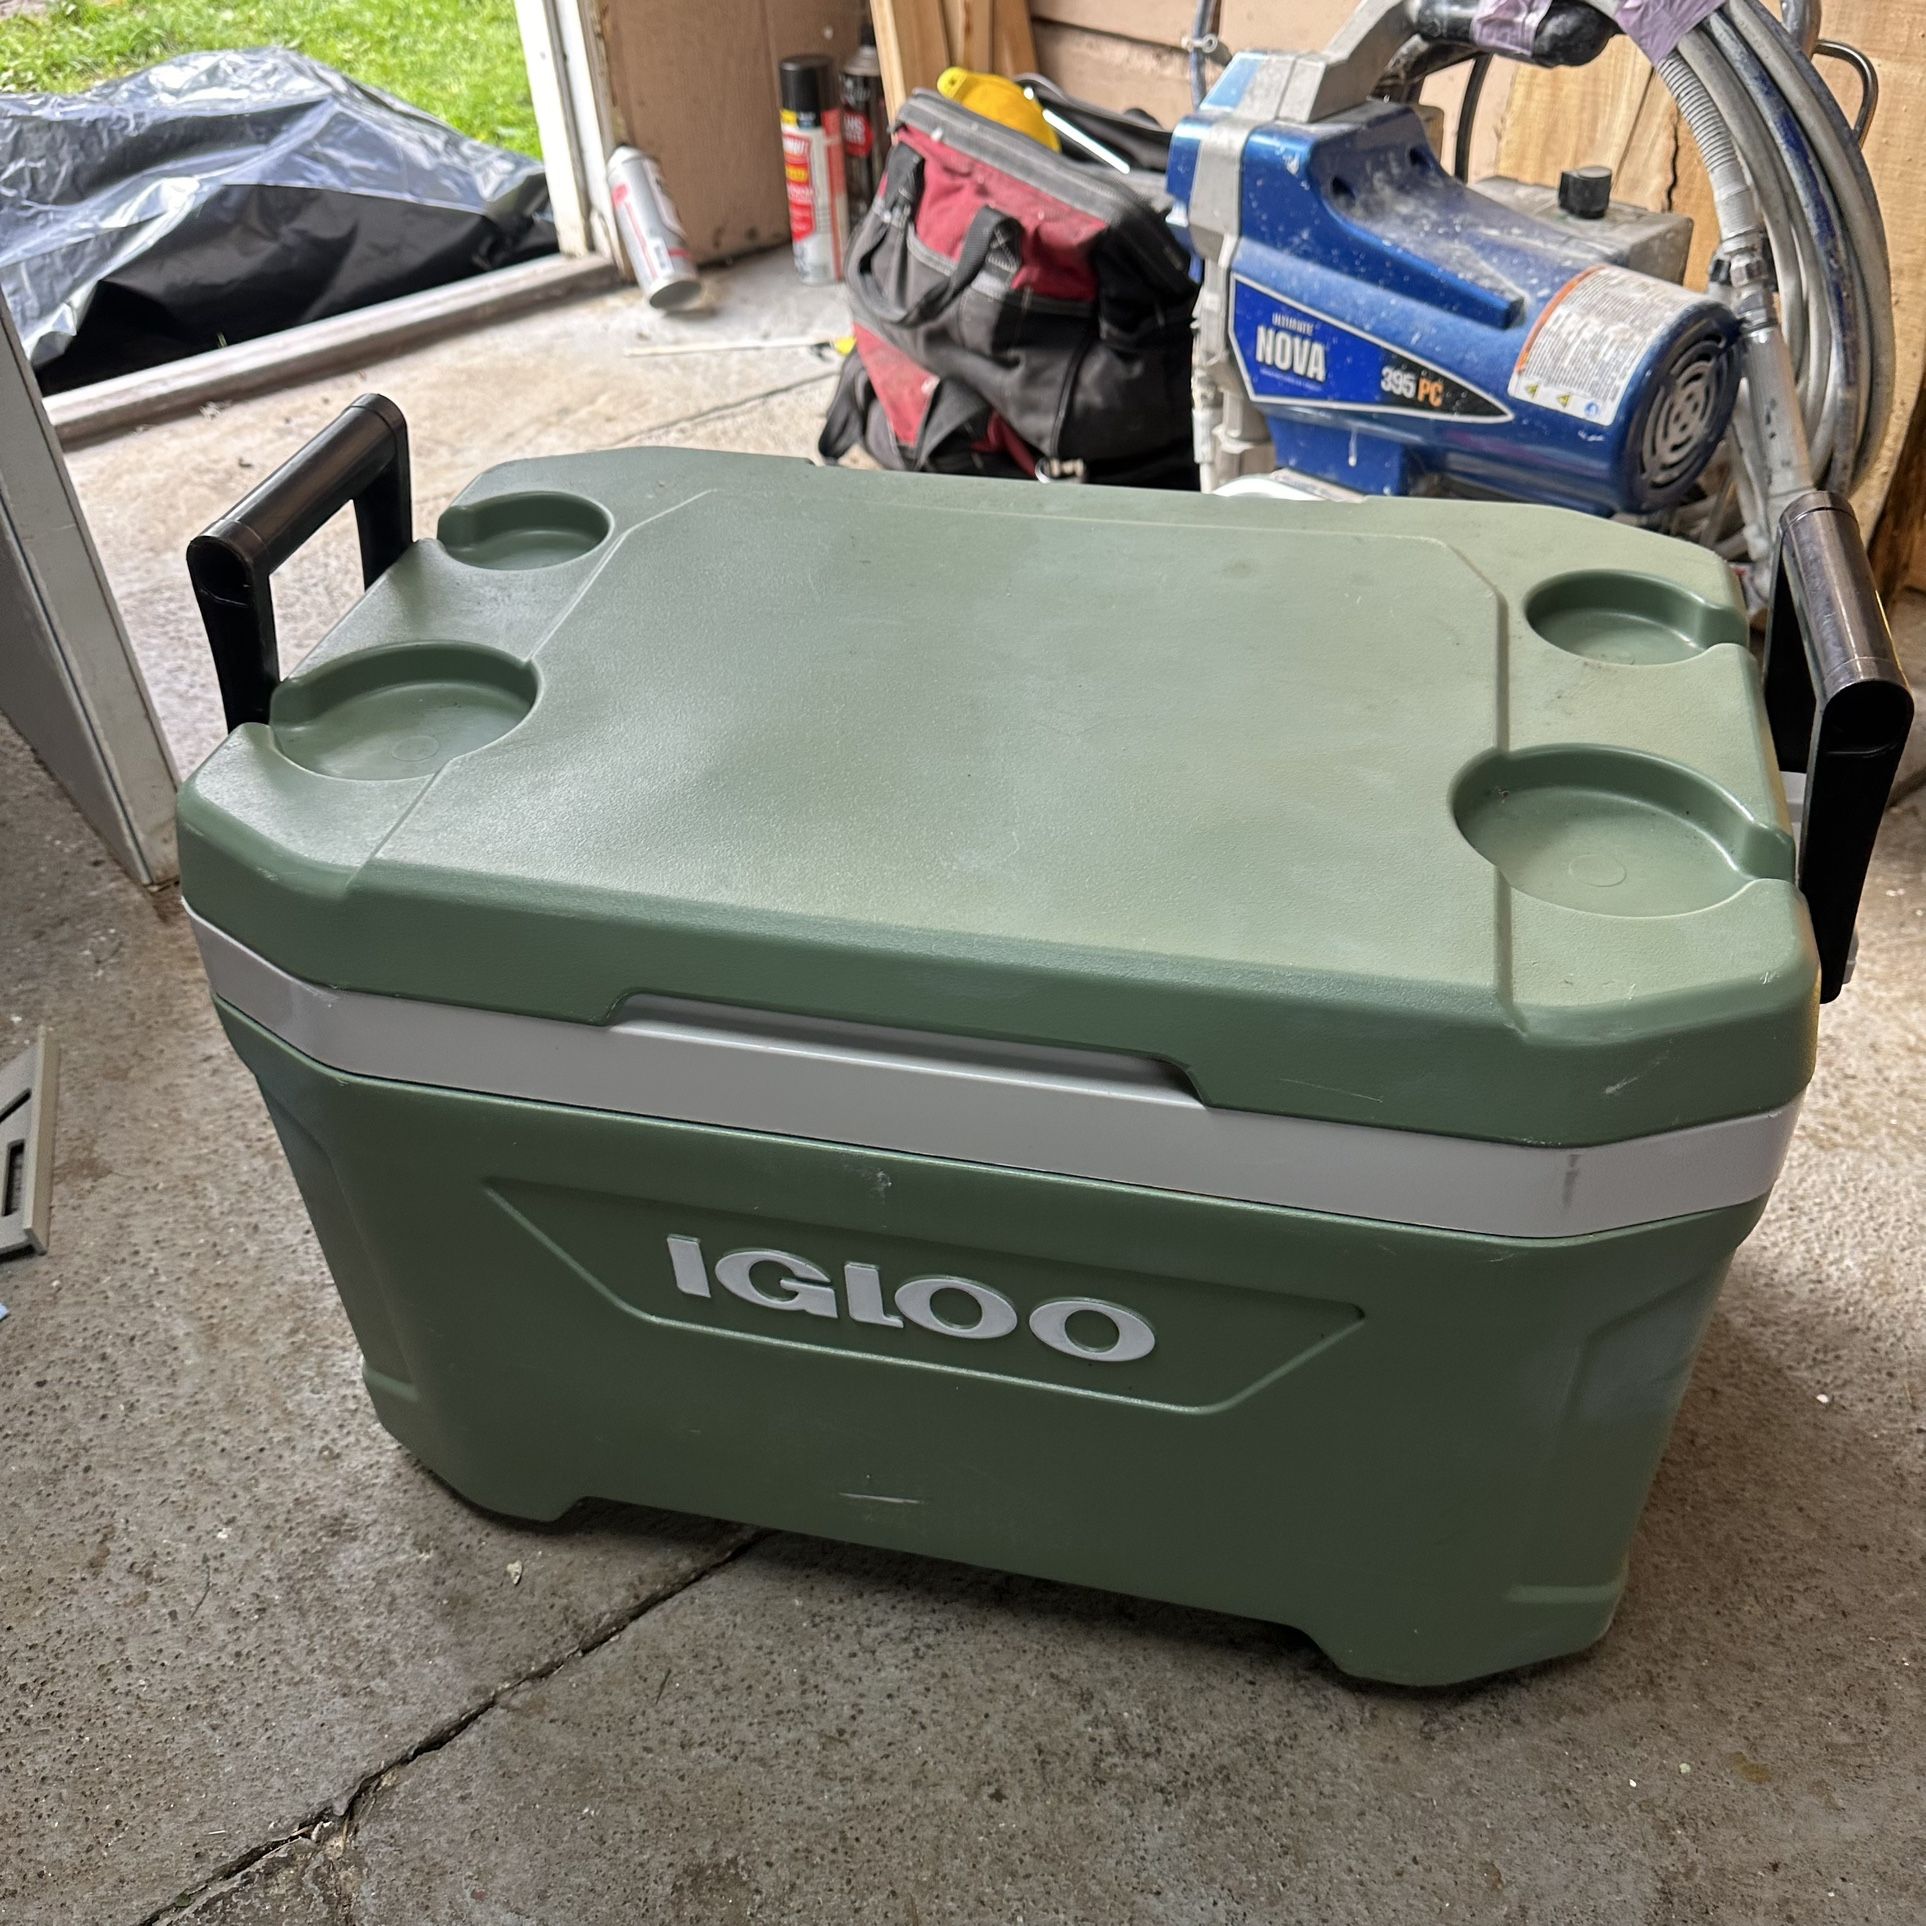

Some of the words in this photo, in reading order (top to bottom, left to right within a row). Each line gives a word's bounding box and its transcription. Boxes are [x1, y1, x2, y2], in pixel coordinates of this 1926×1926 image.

[1256, 325, 1325, 382] NOVA
[1381, 366, 1417, 399] 395
[1417, 378, 1444, 407] PC
[667, 1235, 1156, 1362] IGLOO
